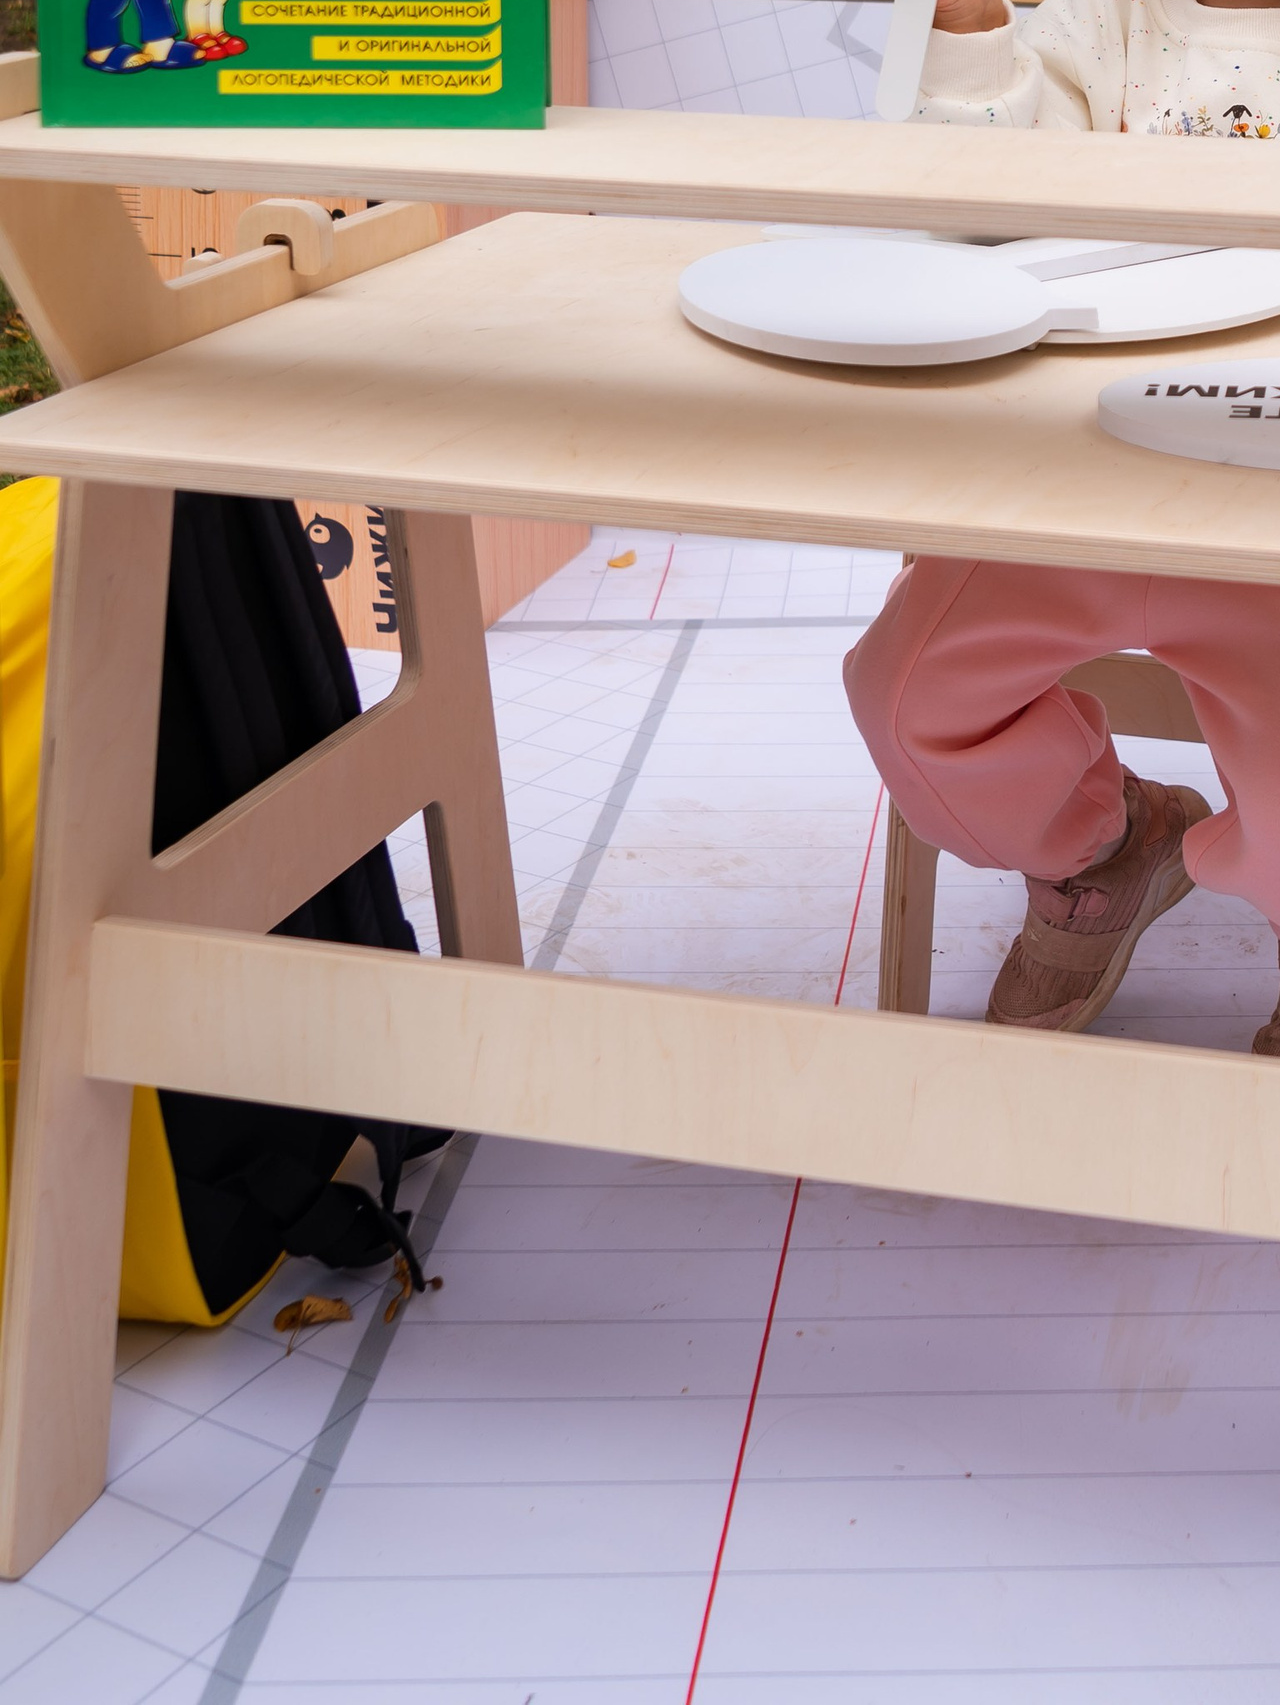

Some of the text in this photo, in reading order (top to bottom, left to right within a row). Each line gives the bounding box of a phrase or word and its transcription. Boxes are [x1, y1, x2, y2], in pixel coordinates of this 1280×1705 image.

[252, 3, 492, 19] СОЧЕТАНИЕ ТРАДИЦИОННОЙ
[338, 38, 492, 53] И ОРИГИНАЛЬНОЙ
[233, 70, 492, 88] ЛОГОПЕДИЧЕСКОЙ МЕТОДИКИ
